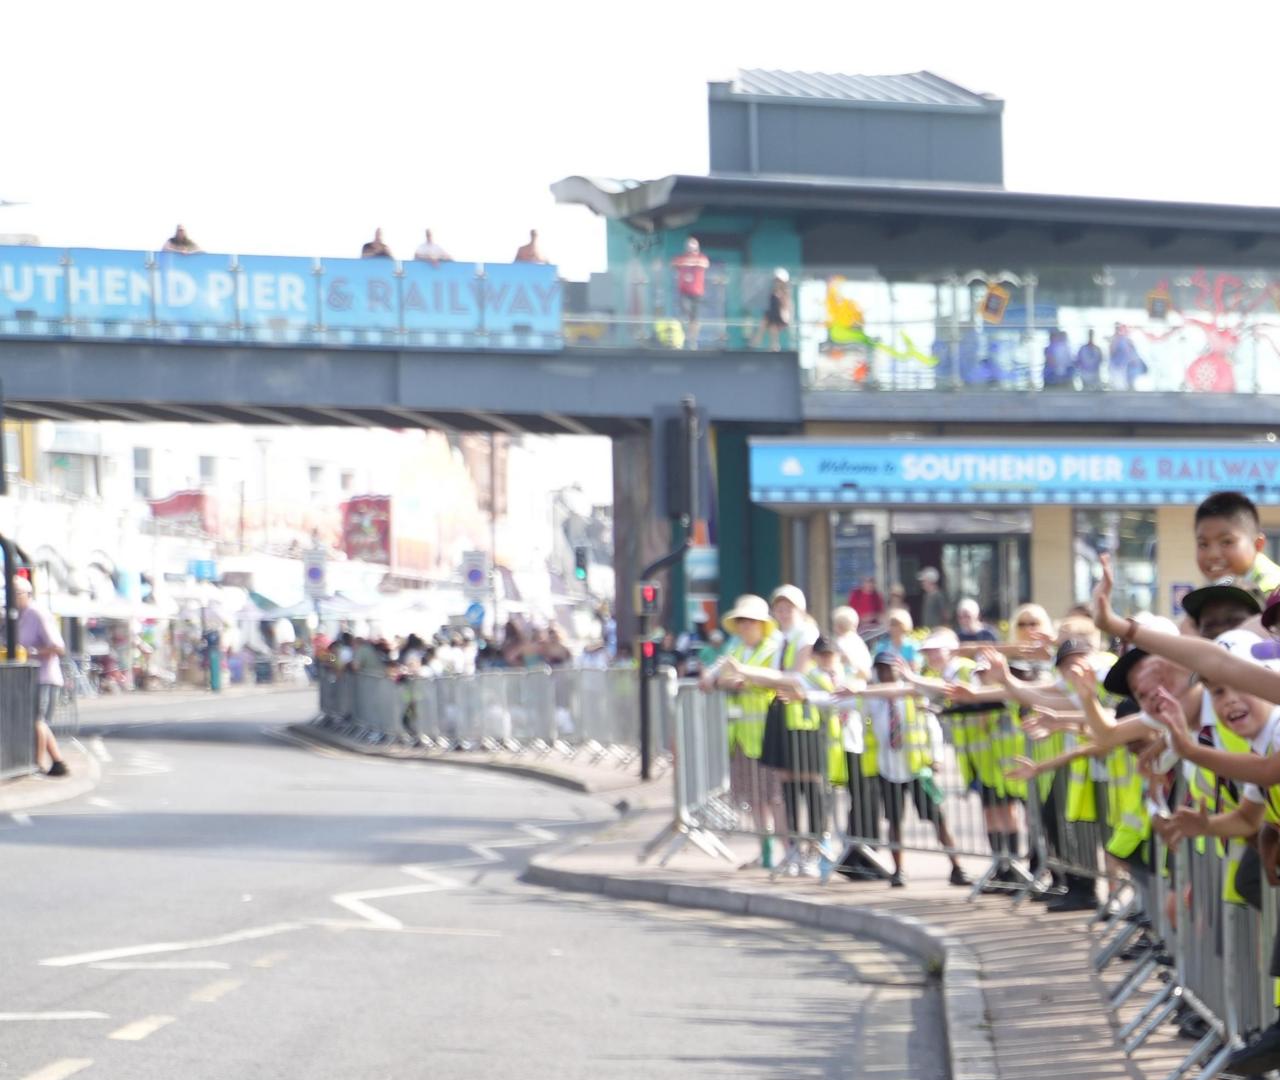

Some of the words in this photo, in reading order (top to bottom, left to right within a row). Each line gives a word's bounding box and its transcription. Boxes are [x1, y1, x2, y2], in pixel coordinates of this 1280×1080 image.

[0, 263, 198, 308] UTHEND
[207, 271, 307, 312] PIER
[325, 275, 355, 313] &
[366, 276, 561, 317] RAILWAY
[903, 454, 1059, 482] SOUTHEND
[1061, 454, 1124, 482] PIER
[1129, 455, 1147, 481] &
[1156, 456, 1280, 482] RAILWAY
